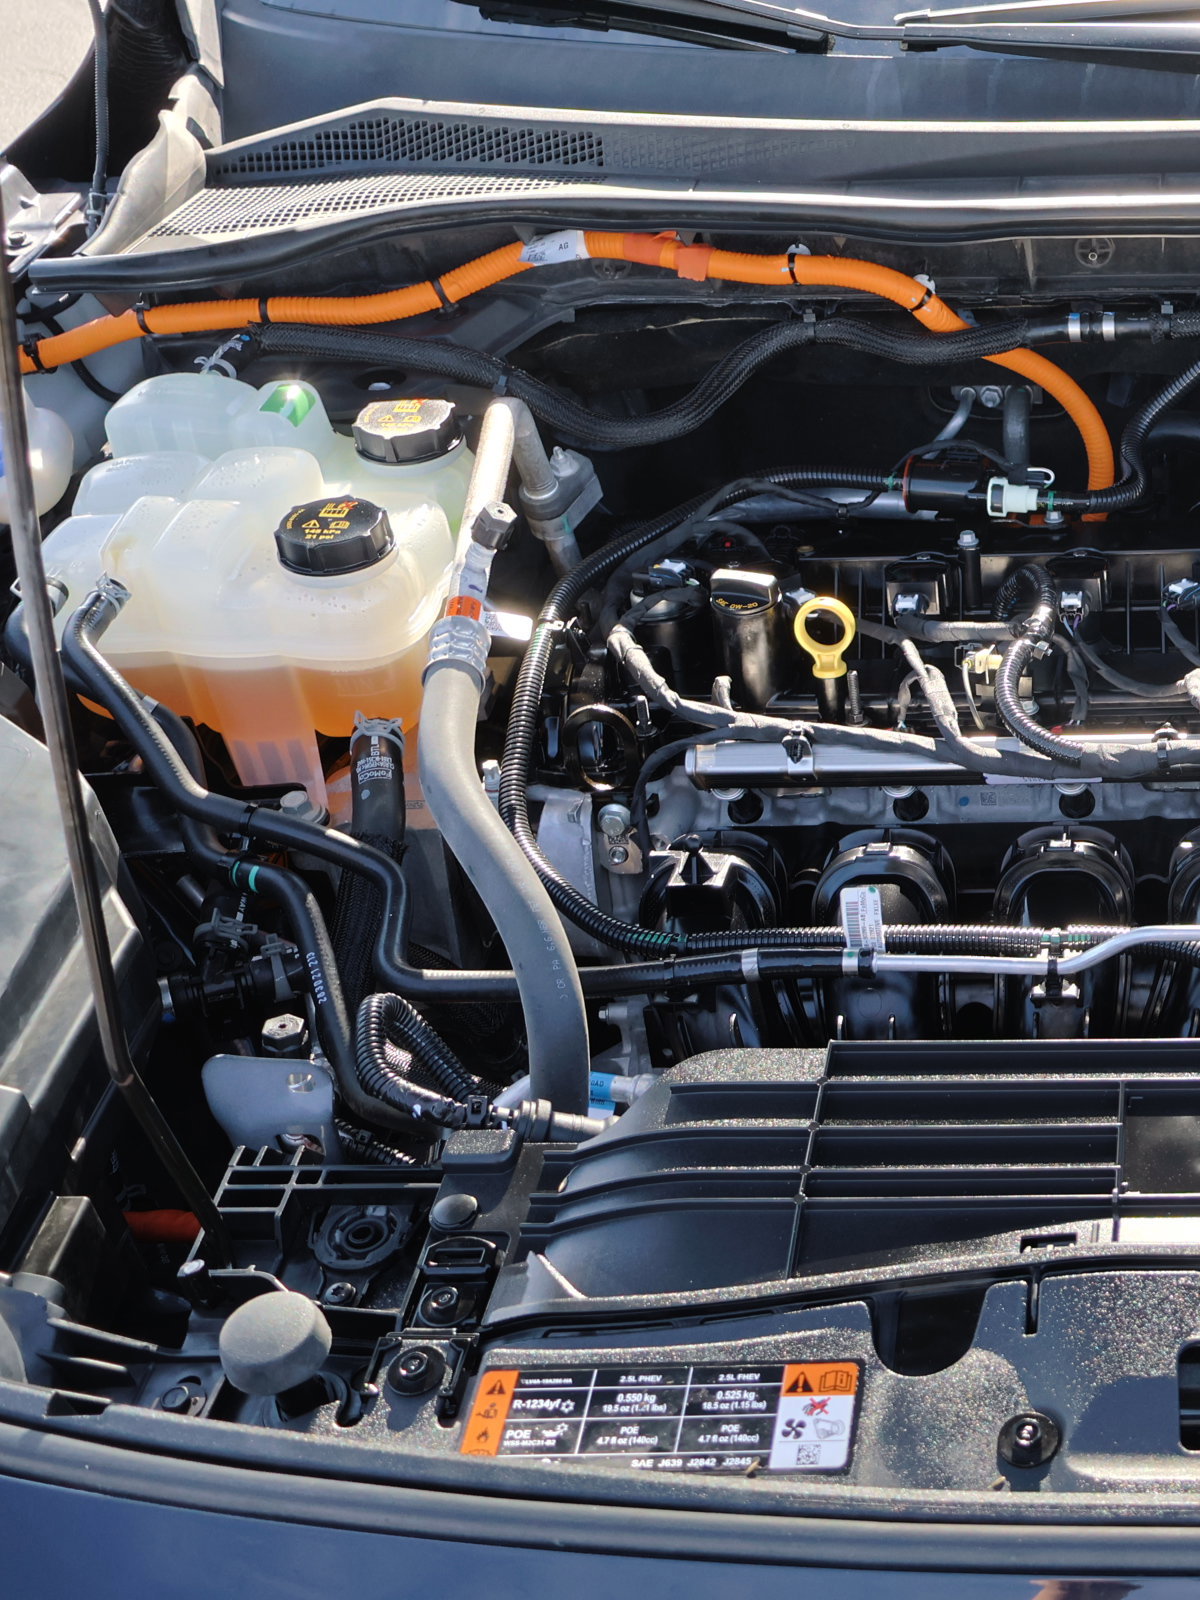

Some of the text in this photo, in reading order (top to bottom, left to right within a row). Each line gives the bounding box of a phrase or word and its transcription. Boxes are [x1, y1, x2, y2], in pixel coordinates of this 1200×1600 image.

[558, 242, 569, 251] AG
[619, 1374, 663, 1384] 2.5L PHEV
[718, 1372, 761, 1382] 2.5L FHEV
[616, 1392, 657, 1405] 0.550 kg
[716, 1389, 756, 1402] 0.525 kg
[512, 1398, 562, 1412] R-1234yf
[602, 1404, 620, 1413] 19.5
[620, 1404, 630, 1412] oz
[702, 1401, 719, 1410] 18.5
[719, 1401, 730, 1410] oz
[730, 1400, 750, 1411] (1.15
[620, 1425, 640, 1435] POE
[720, 1423, 741, 1433] POE
[505, 1429, 532, 1440] POE
[698, 1434, 711, 1444] 4.7
[595, 1436, 610, 1445] 4.7
[631, 1456, 753, 1468] SAE J639 J2842 J2845
